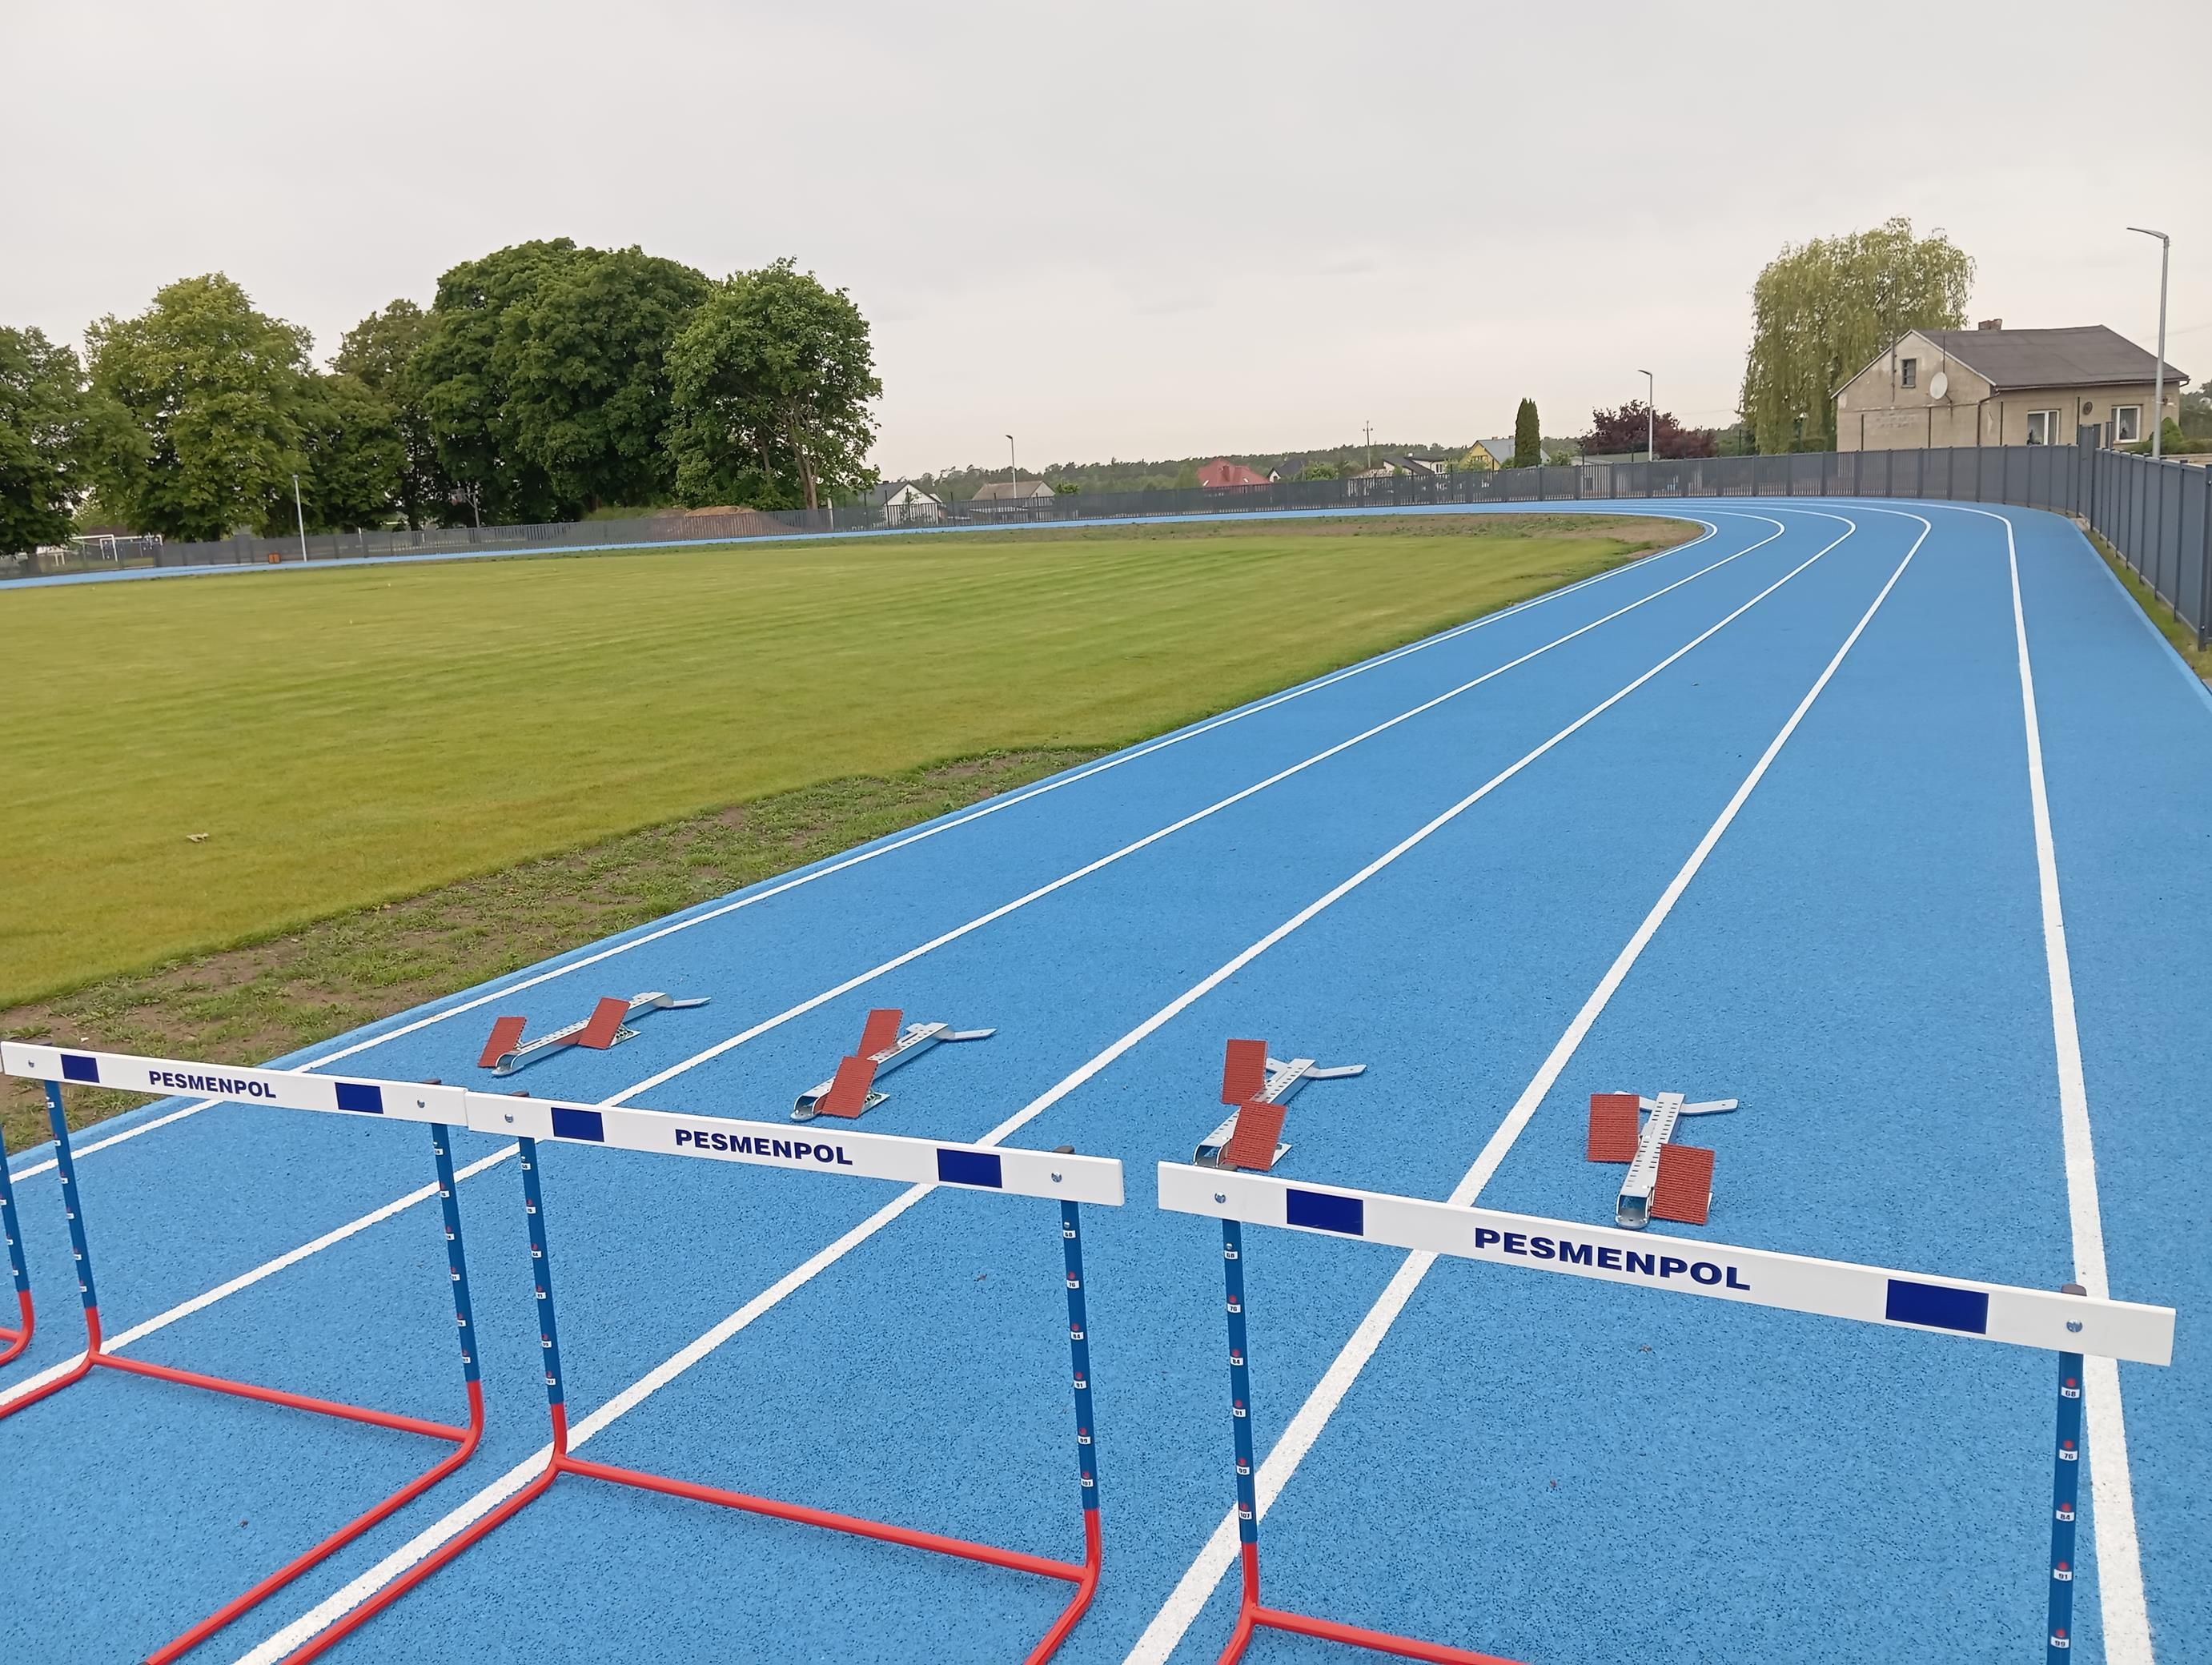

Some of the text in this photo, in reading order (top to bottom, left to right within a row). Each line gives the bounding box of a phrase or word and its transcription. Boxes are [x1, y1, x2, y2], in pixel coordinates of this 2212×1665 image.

[150, 1070, 276, 1098] PESMENPOL
[676, 1129, 853, 1166] PESMENPOL
[1475, 1227, 1751, 1291] PESMENPOL
